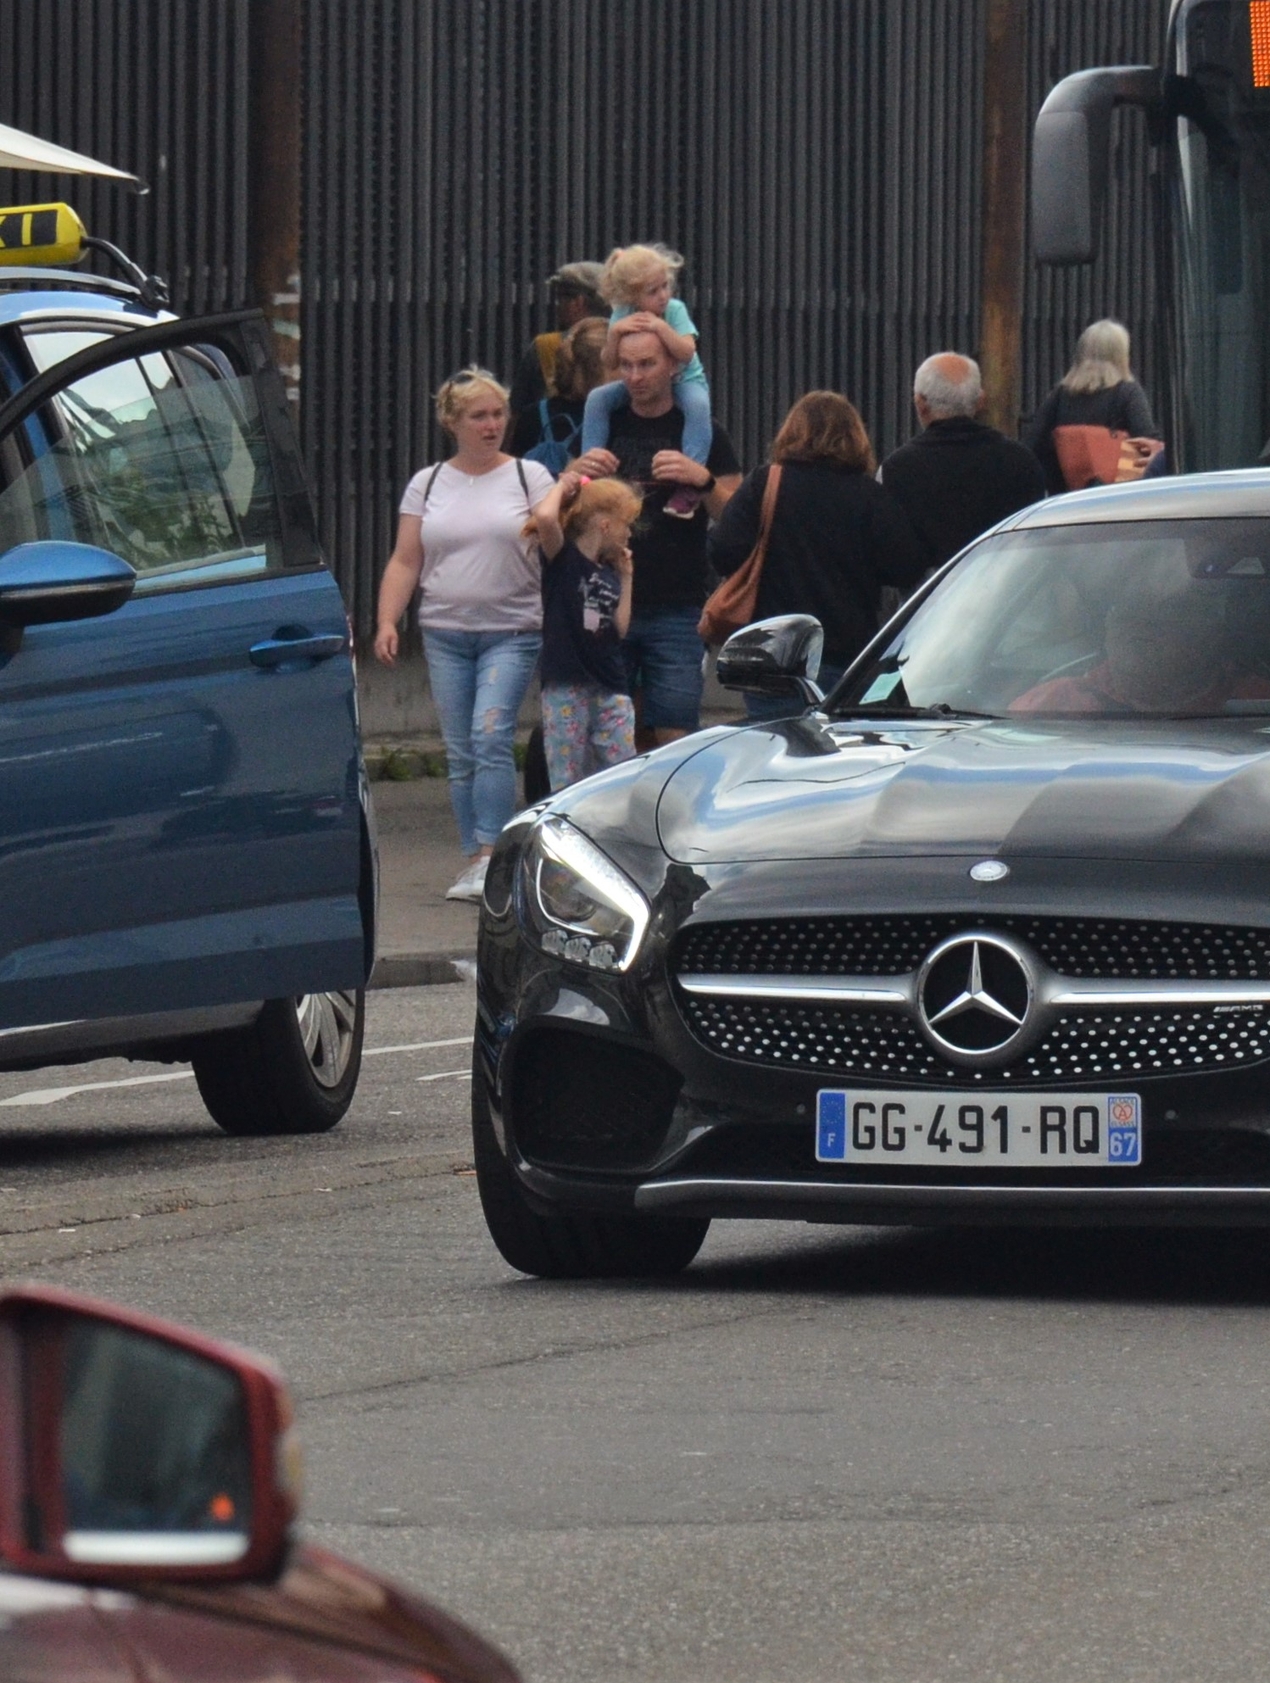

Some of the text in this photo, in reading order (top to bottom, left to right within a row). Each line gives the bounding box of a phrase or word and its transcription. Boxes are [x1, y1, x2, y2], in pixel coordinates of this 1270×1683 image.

[827, 1132, 837, 1148] F
[852, 1102, 1100, 1154] GG-491-RQ
[1110, 1131, 1137, 1157] 67
